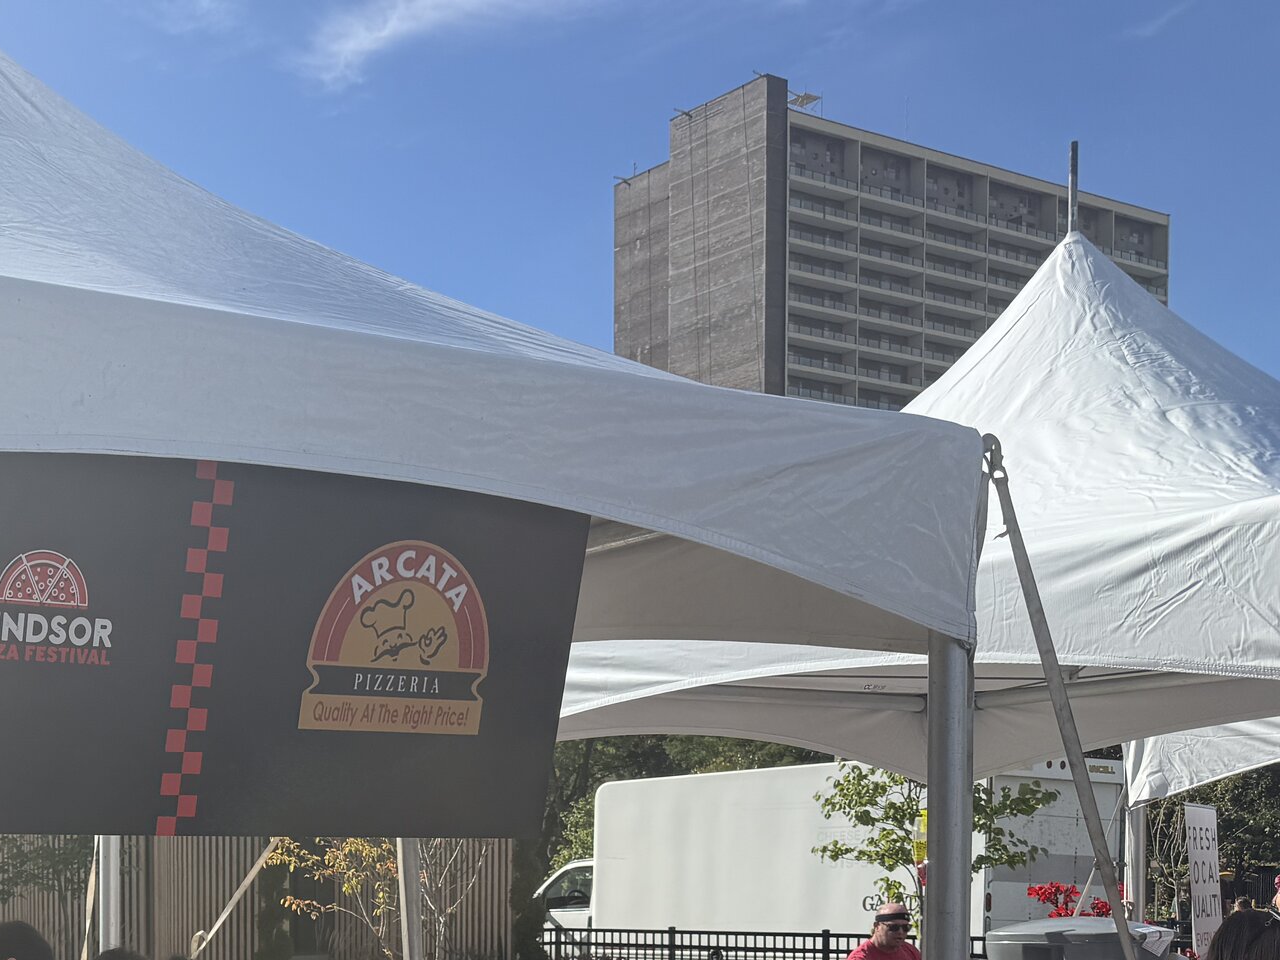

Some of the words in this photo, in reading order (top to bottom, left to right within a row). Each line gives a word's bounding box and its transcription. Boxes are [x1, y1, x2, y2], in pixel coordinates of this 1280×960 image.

[351, 550, 468, 613] ARCATA
[24, 645, 111, 666] FESTIVAL
[353, 673, 439, 694] PIZZERIA
[312, 701, 357, 726] Quality
[360, 703, 376, 723] At
[378, 703, 398, 723] The
[401, 706, 432, 730] Right
[434, 707, 470, 727] Price!
[1193, 860, 1219, 885] OCAL
